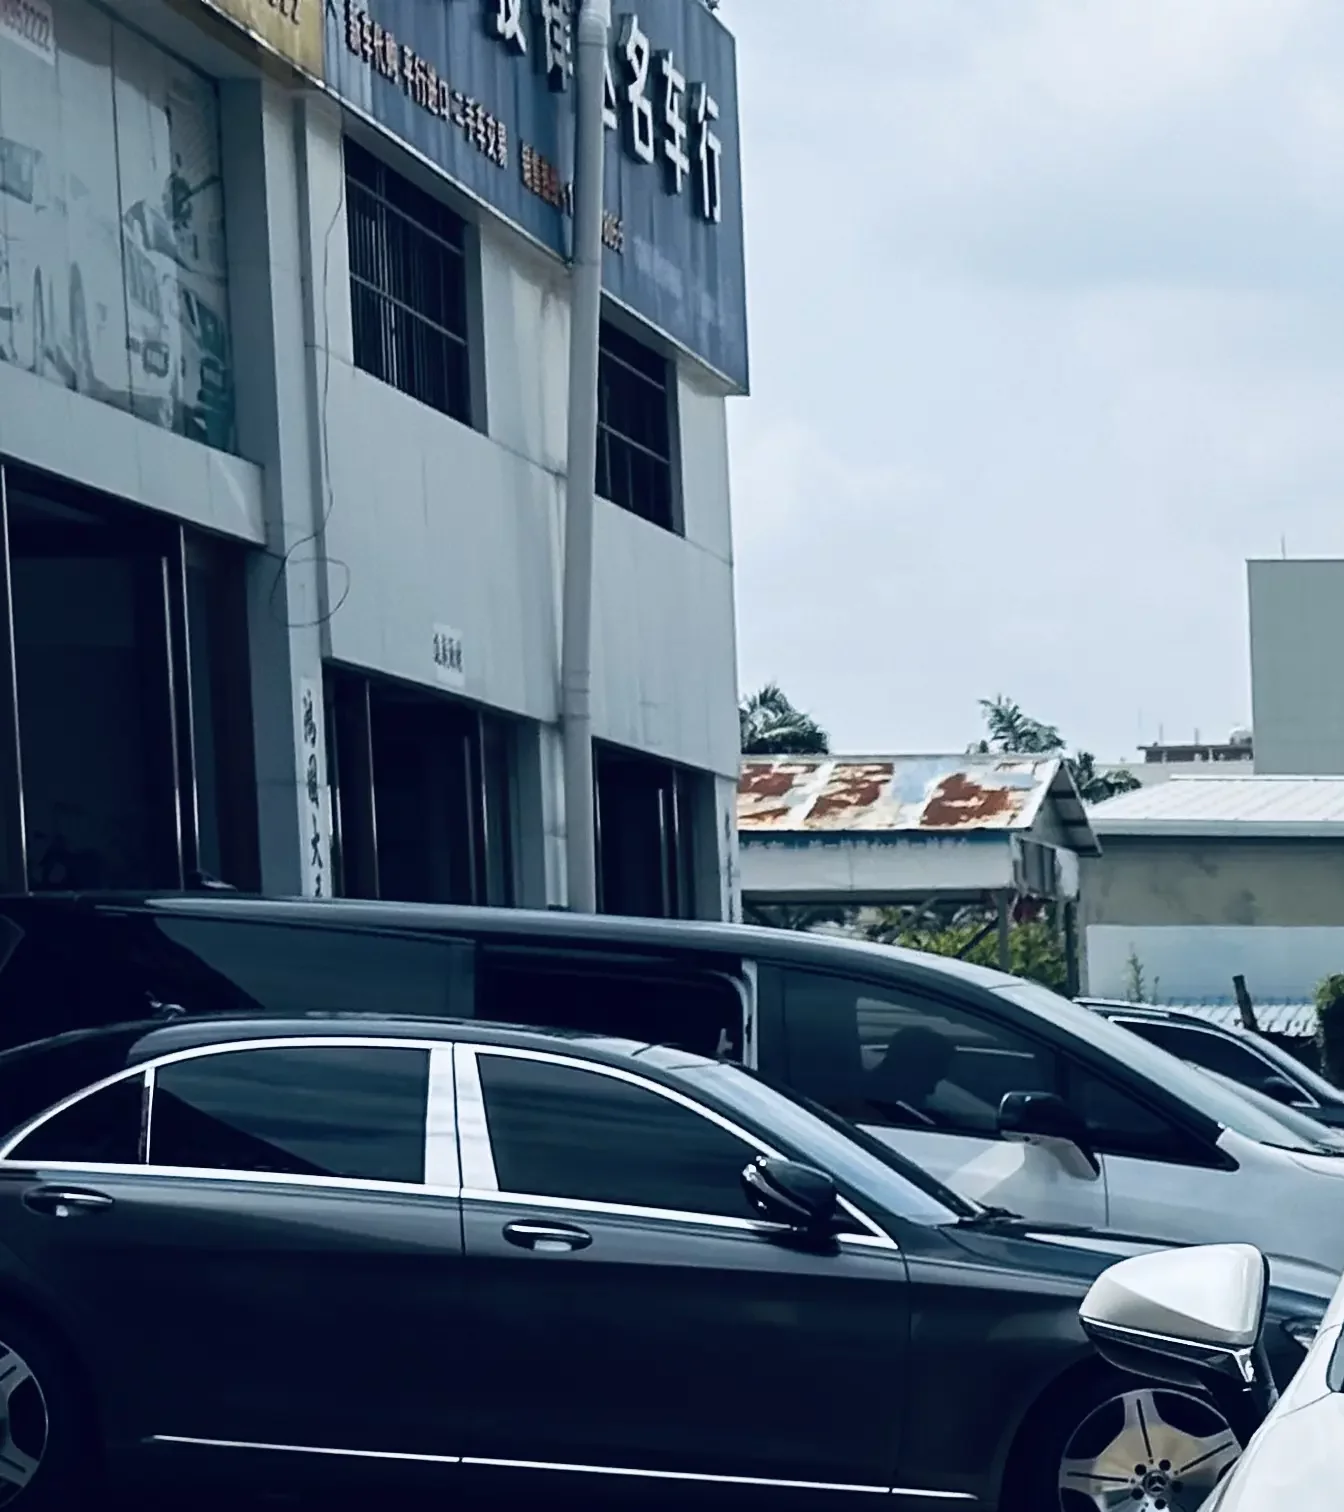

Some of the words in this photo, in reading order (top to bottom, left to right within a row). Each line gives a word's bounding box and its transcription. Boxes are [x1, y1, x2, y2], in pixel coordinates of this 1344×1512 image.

[402, 45, 449, 123] 平行进口
[454, 90, 507, 170] 二手车交易
